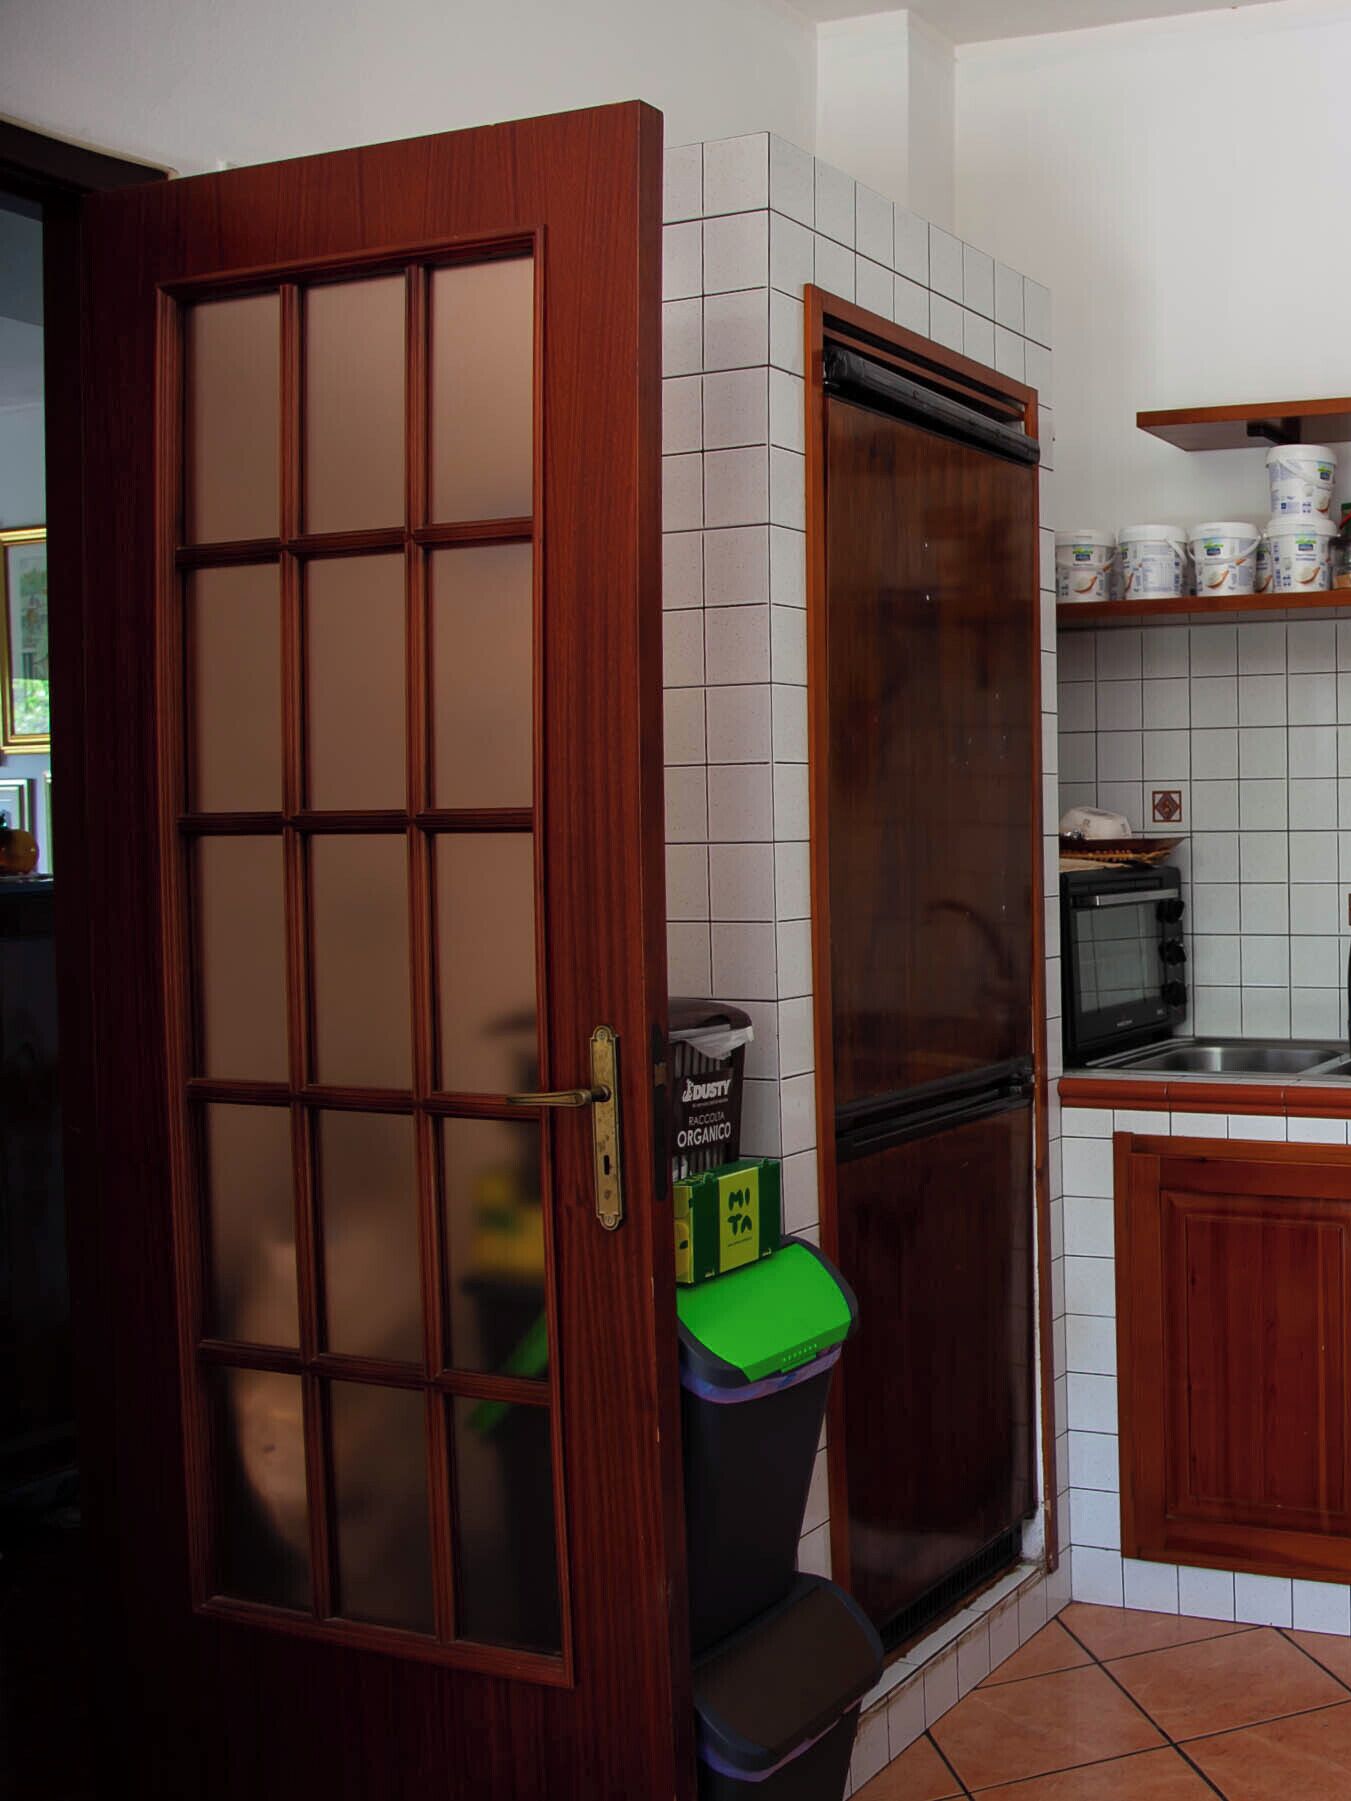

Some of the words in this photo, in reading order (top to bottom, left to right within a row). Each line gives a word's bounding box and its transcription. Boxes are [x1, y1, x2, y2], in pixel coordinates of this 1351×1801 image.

[693, 1079, 731, 1101] DUSTY
[688, 1111, 726, 1126] RACCOLTA
[677, 1121, 732, 1148] ORGANICO
